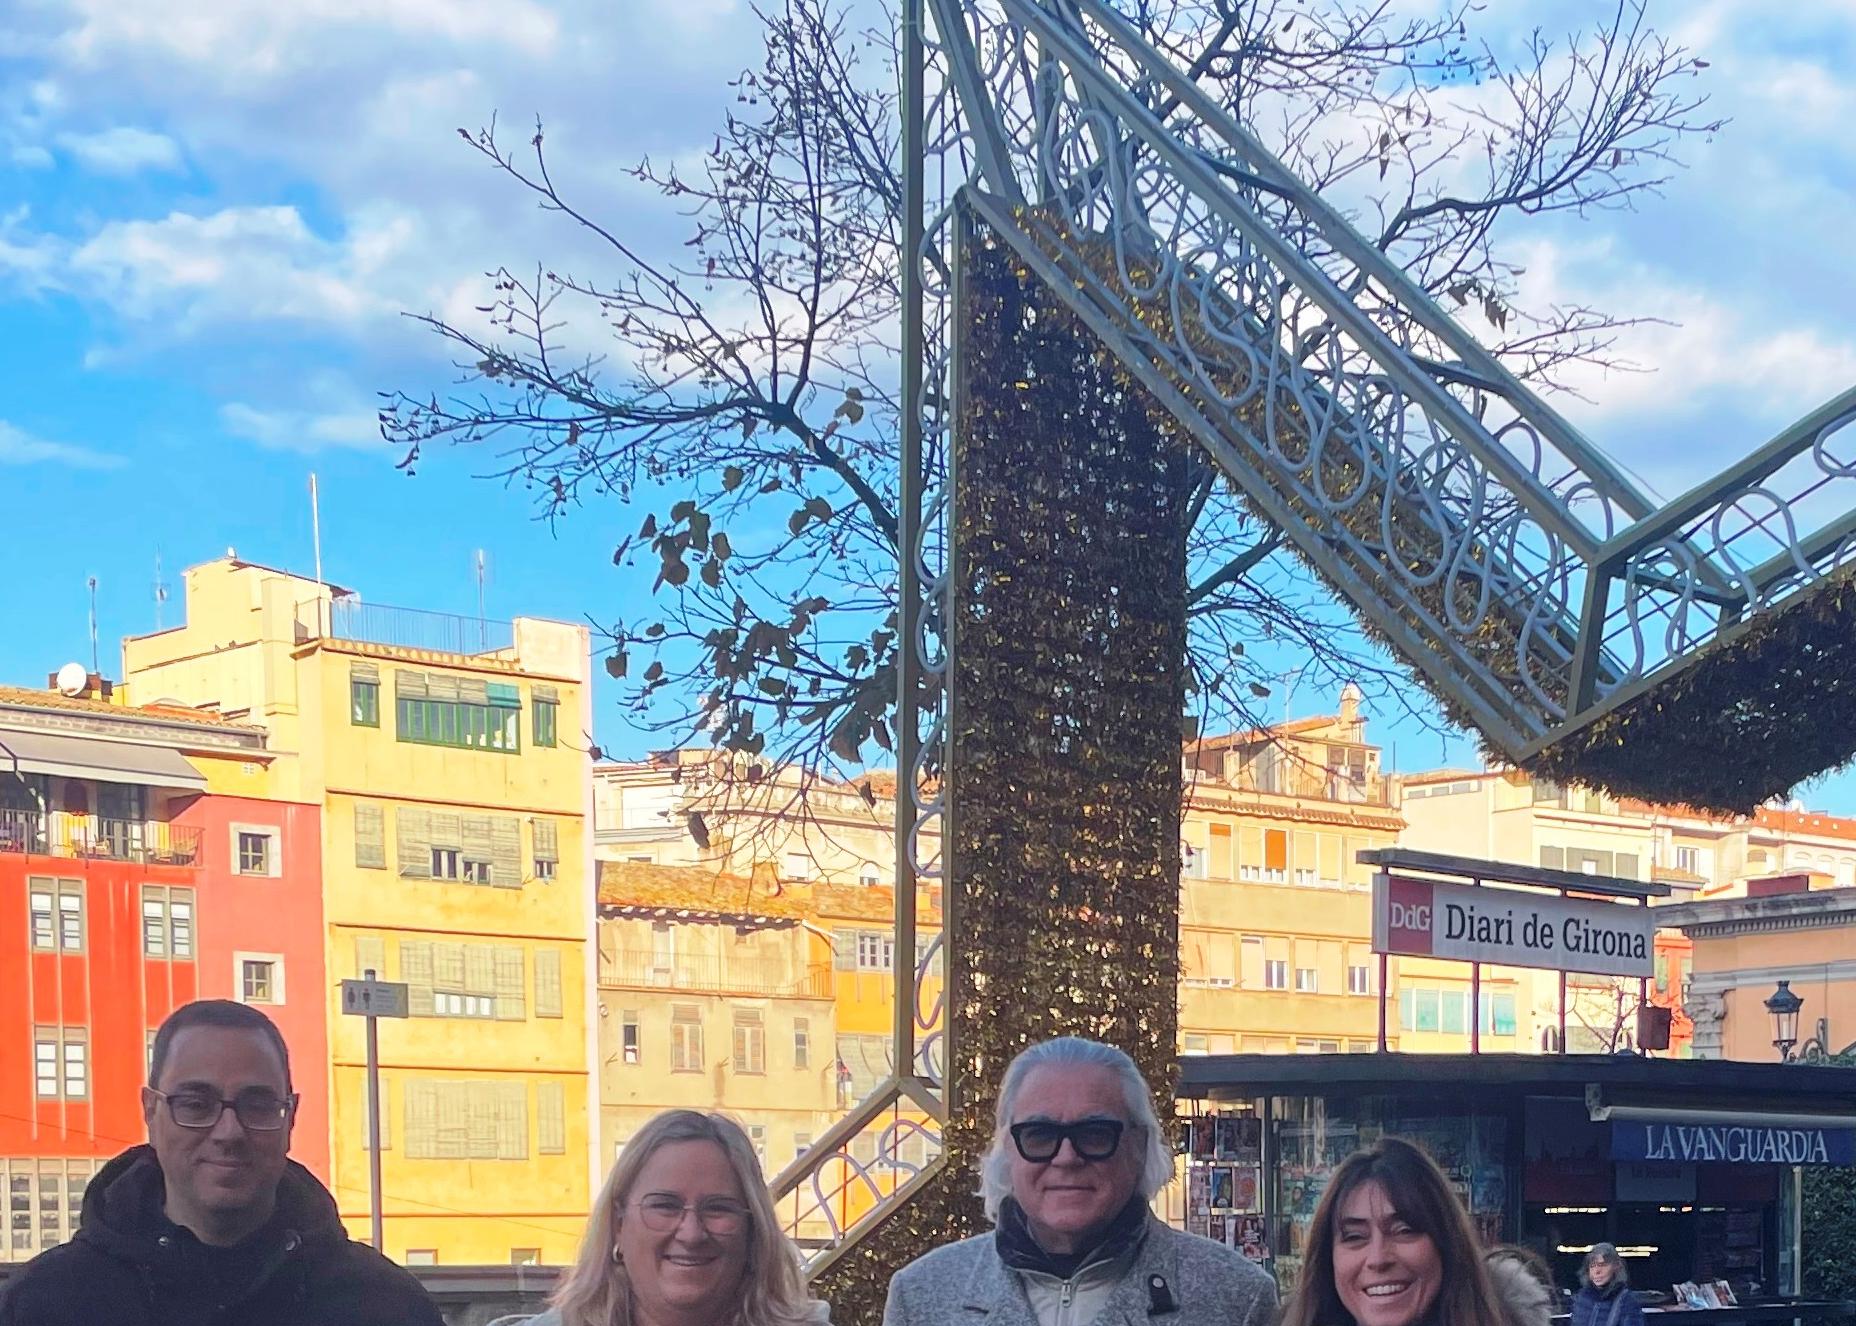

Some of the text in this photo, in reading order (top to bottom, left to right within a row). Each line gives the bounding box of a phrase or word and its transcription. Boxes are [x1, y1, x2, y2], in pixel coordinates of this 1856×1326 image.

[1390, 902, 1432, 931] DdG
[1445, 903, 1647, 960] Diari de Girona
[1645, 1125, 1829, 1164] LA VANGUARDIA
